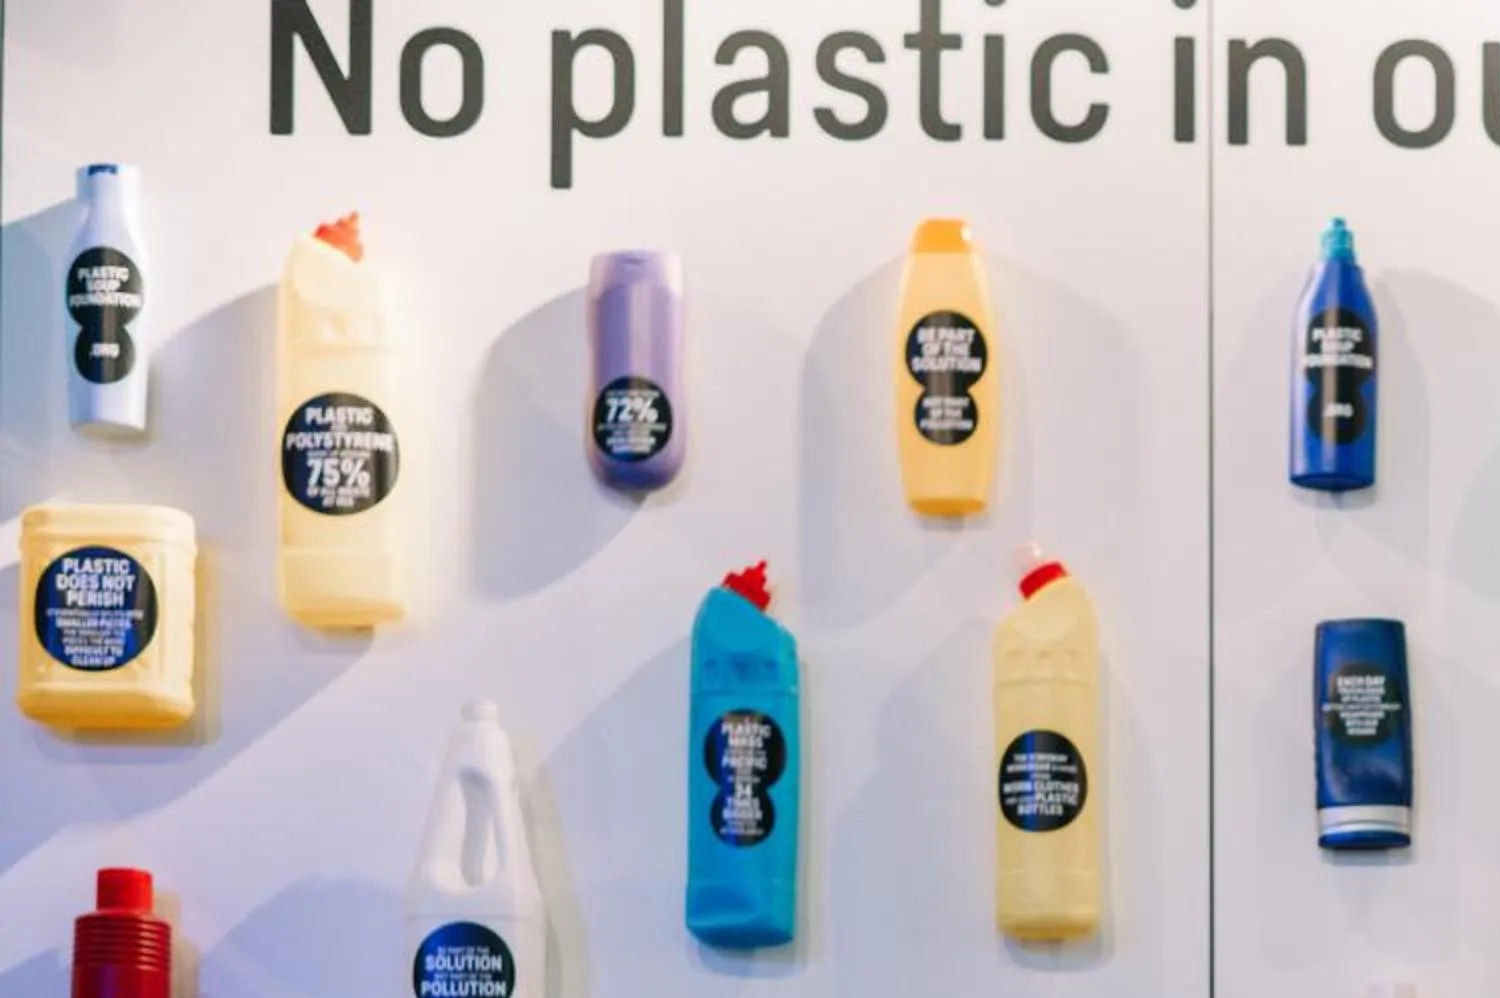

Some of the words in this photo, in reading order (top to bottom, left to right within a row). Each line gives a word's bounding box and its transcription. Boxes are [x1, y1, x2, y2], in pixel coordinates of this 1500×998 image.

[270, 0, 483, 137] No
[551, 0, 1109, 188] plastic
[1174, 0, 1307, 146] in
[78, 267, 128, 283] PLASTIC
[938, 328, 975, 343] PART
[913, 356, 982, 372] SOLUTION
[305, 407, 374, 425] PLASTIC
[607, 397, 658, 423] 72%
[286, 431, 394, 451] POLYSTYRENE
[305, 458, 371, 486] 75%
[64, 559, 131, 574] PLASTIC
[56, 575, 99, 590] DOES
[102, 575, 136, 590] NOT
[67, 591, 124, 607] PERISH
[722, 724, 771, 738] PLASTIC
[1016, 804, 1063, 817] BOTTLES
[424, 954, 503, 972] SOLUTION
[421, 980, 506, 998] POLLUTION
